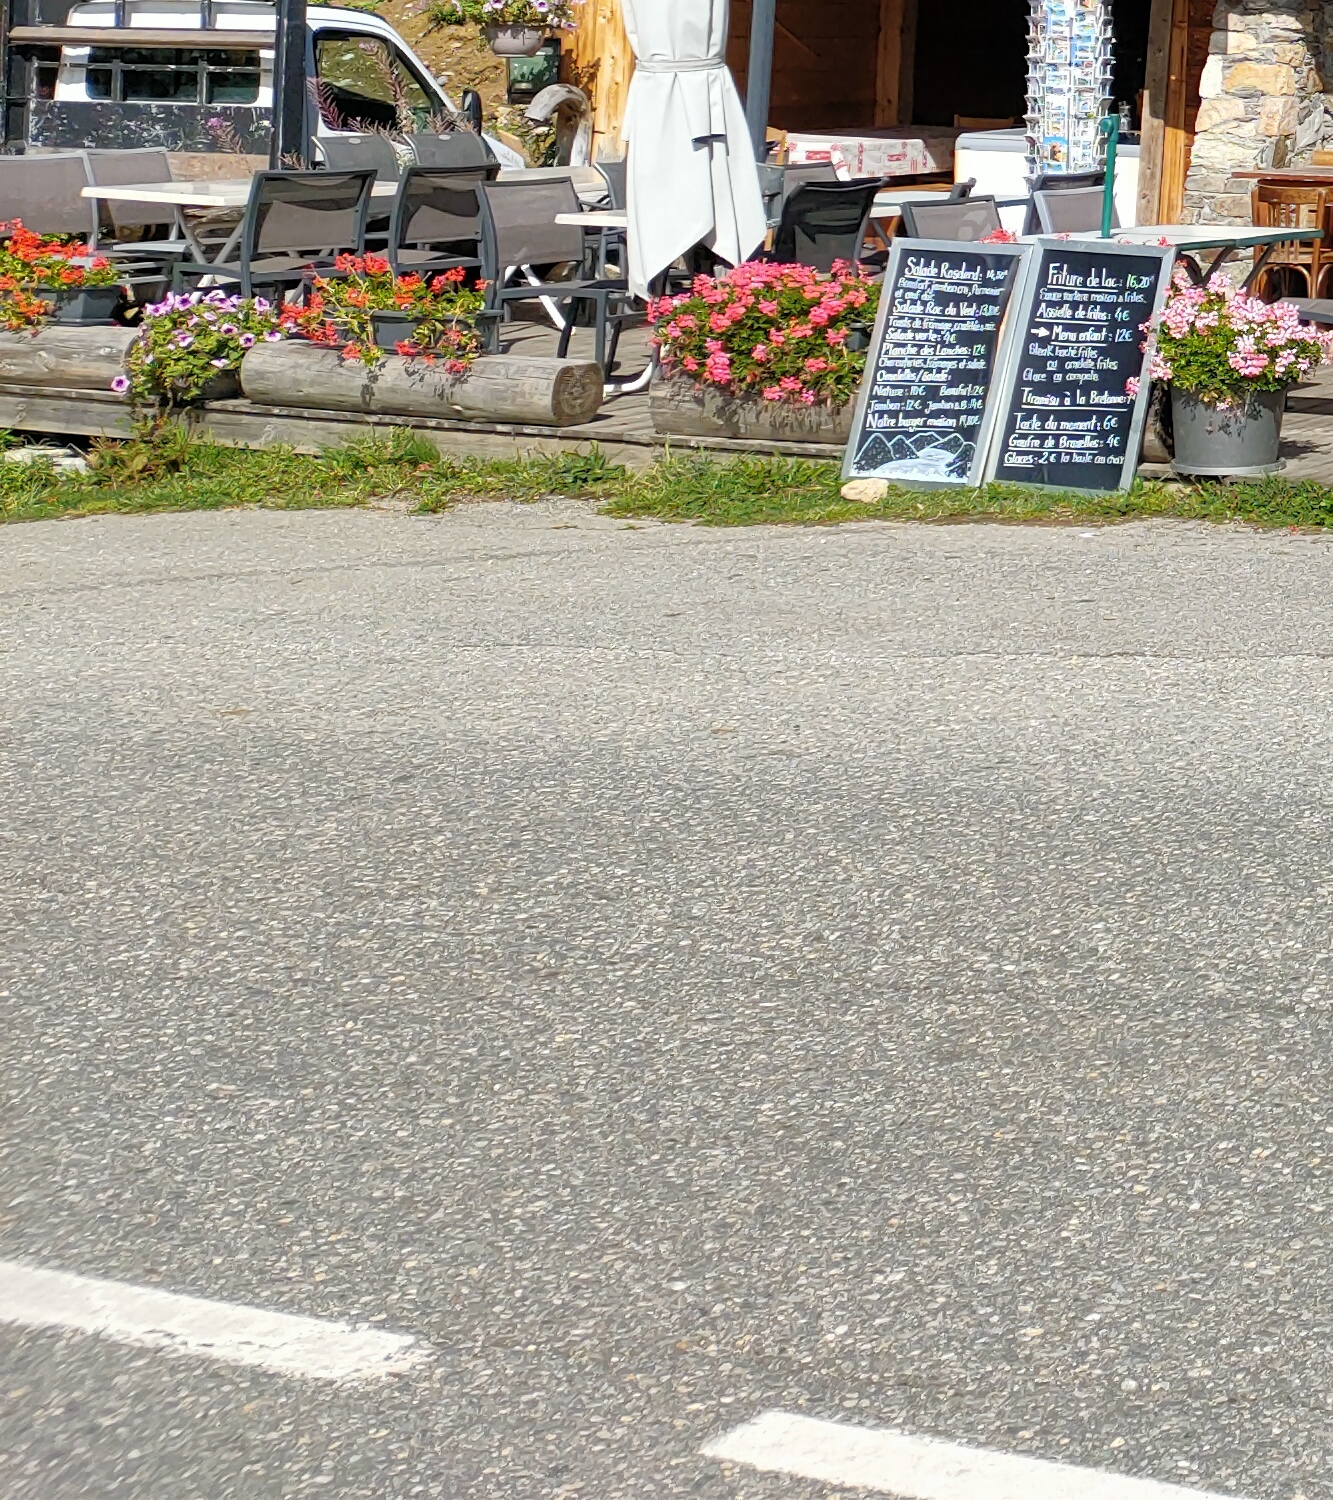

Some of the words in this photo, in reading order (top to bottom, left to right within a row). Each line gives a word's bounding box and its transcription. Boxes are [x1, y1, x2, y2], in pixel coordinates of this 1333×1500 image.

[904, 256, 939, 276] Salade
[1047, 262, 1083, 287] Friture
[1086, 267, 1100, 288] de
[892, 299, 924, 314] Salade
[924, 300, 943, 315] Roc
[944, 302, 957, 316] du
[1036, 302, 1073, 319] Assiette
[1074, 304, 1086, 319] de
[1114, 307, 1130, 322] 4€
[884, 327, 915, 341] Salade
[1051, 324, 1077, 341] Menu
[1114, 328, 1133, 343] 12€
[881, 342, 918, 356] Planche
[920, 343, 935, 356] des
[1076, 346, 1098, 359] frites
[1095, 356, 1119, 371] frites
[1022, 367, 1047, 382] Glace
[1020, 387, 1060, 406] Tiramisu
[1063, 390, 1071, 406] à
[1076, 388, 1086, 405] la
[865, 412, 897, 429] Notre
[1013, 412, 1042, 430] Tarte
[1044, 413, 1058, 430] du
[1103, 414, 1119, 431] 6€
[1008, 433, 1041, 448] Gaufre
[1043, 435, 1055, 448] de
[1105, 433, 1121, 448] 4€
[1060, 452, 1069, 464] la
